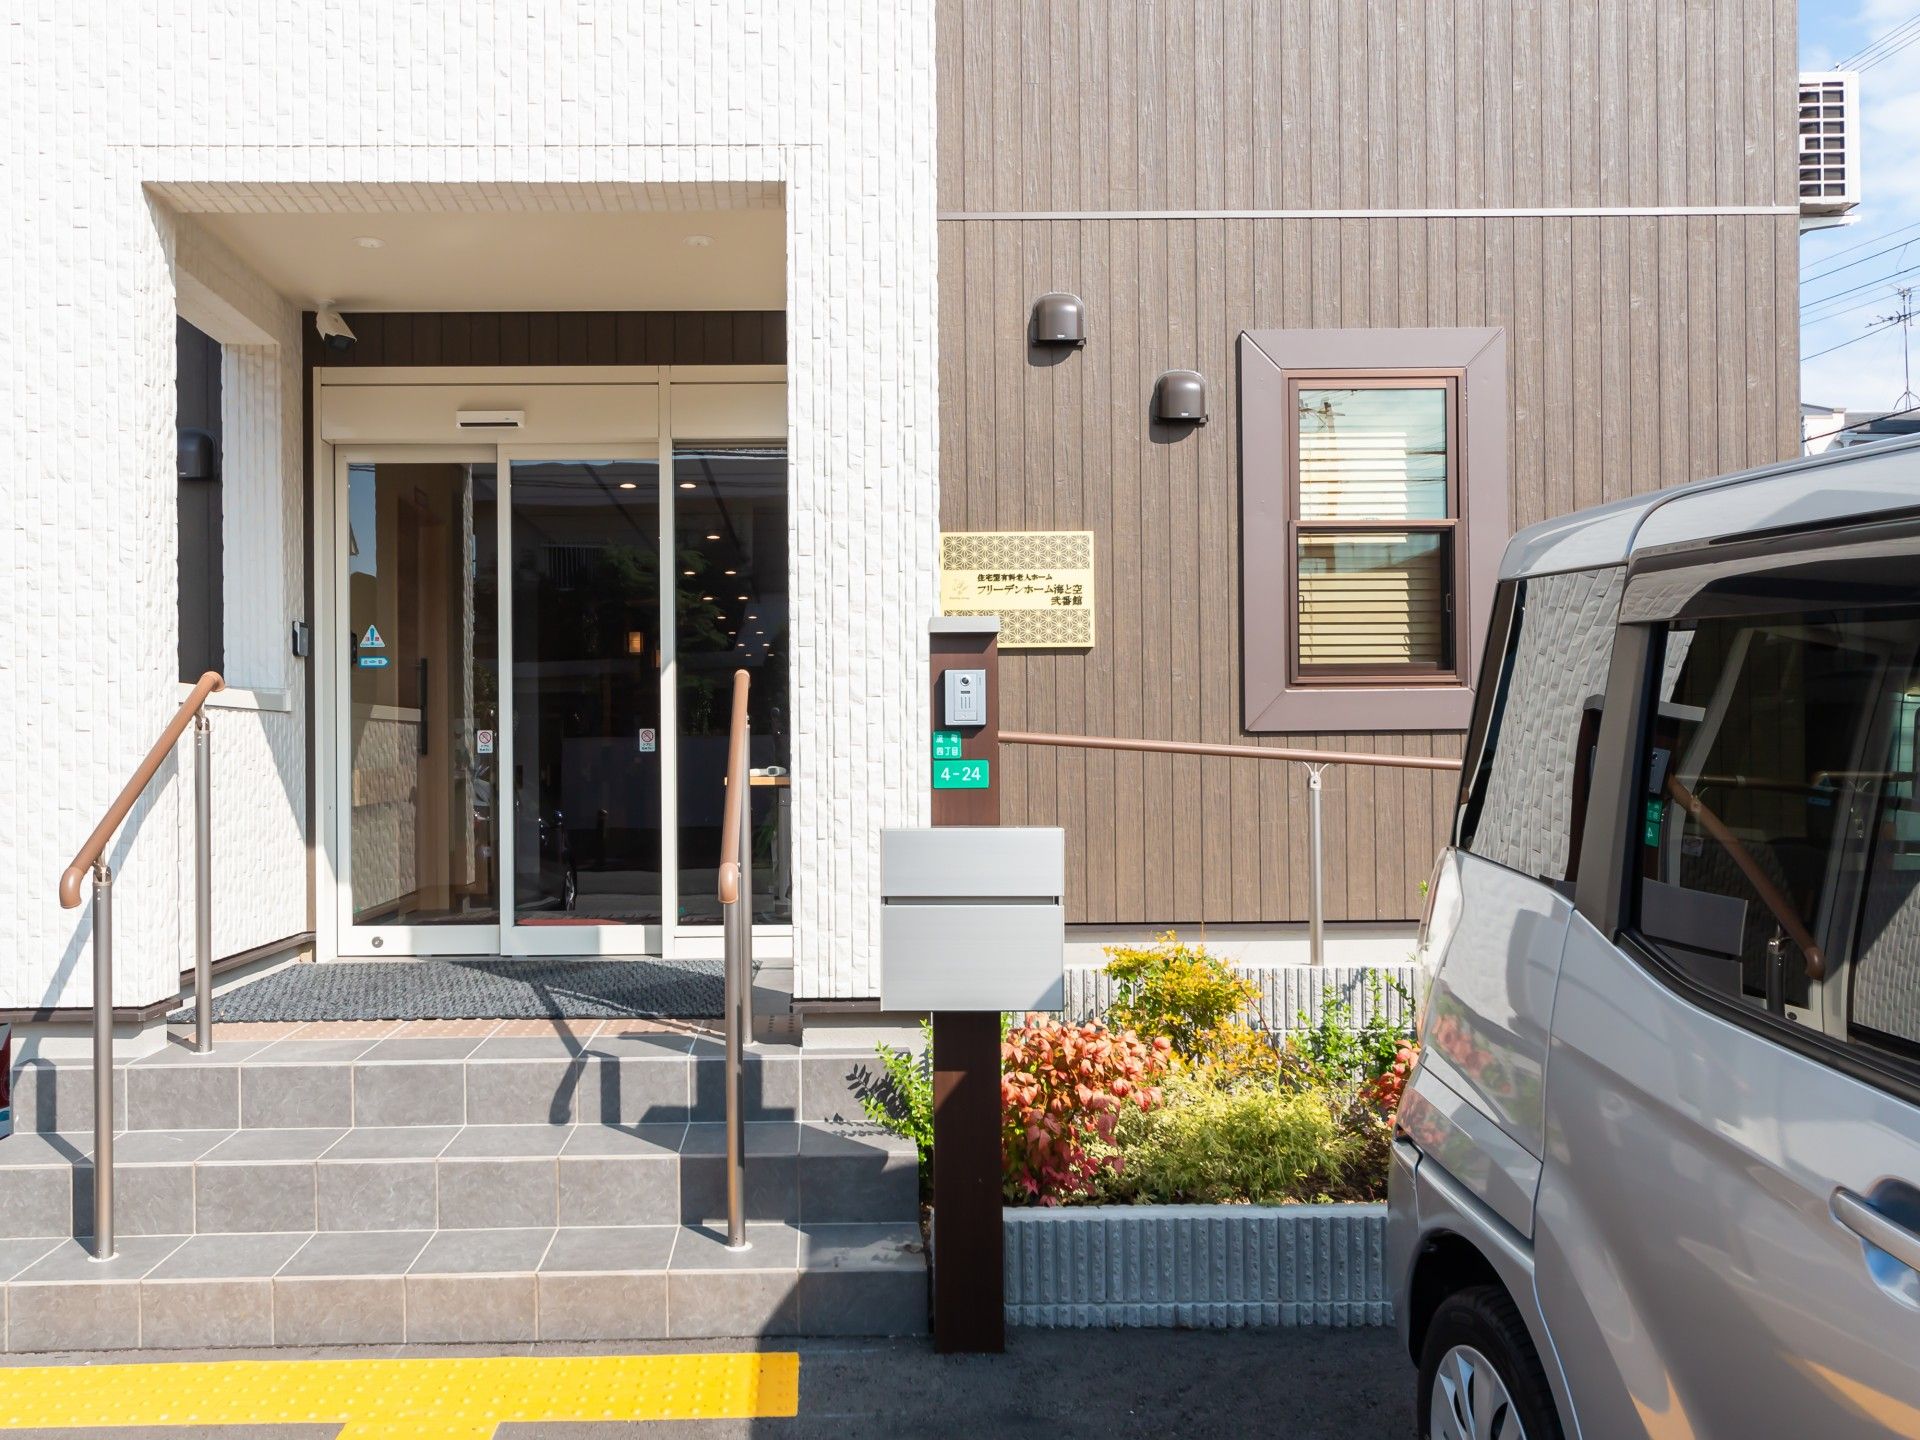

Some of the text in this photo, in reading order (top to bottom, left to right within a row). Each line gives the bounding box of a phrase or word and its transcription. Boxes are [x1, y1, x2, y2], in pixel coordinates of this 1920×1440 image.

[977, 584, 1083, 595] フリーデンホーム海と空
[940, 766, 981, 781] 4-24
